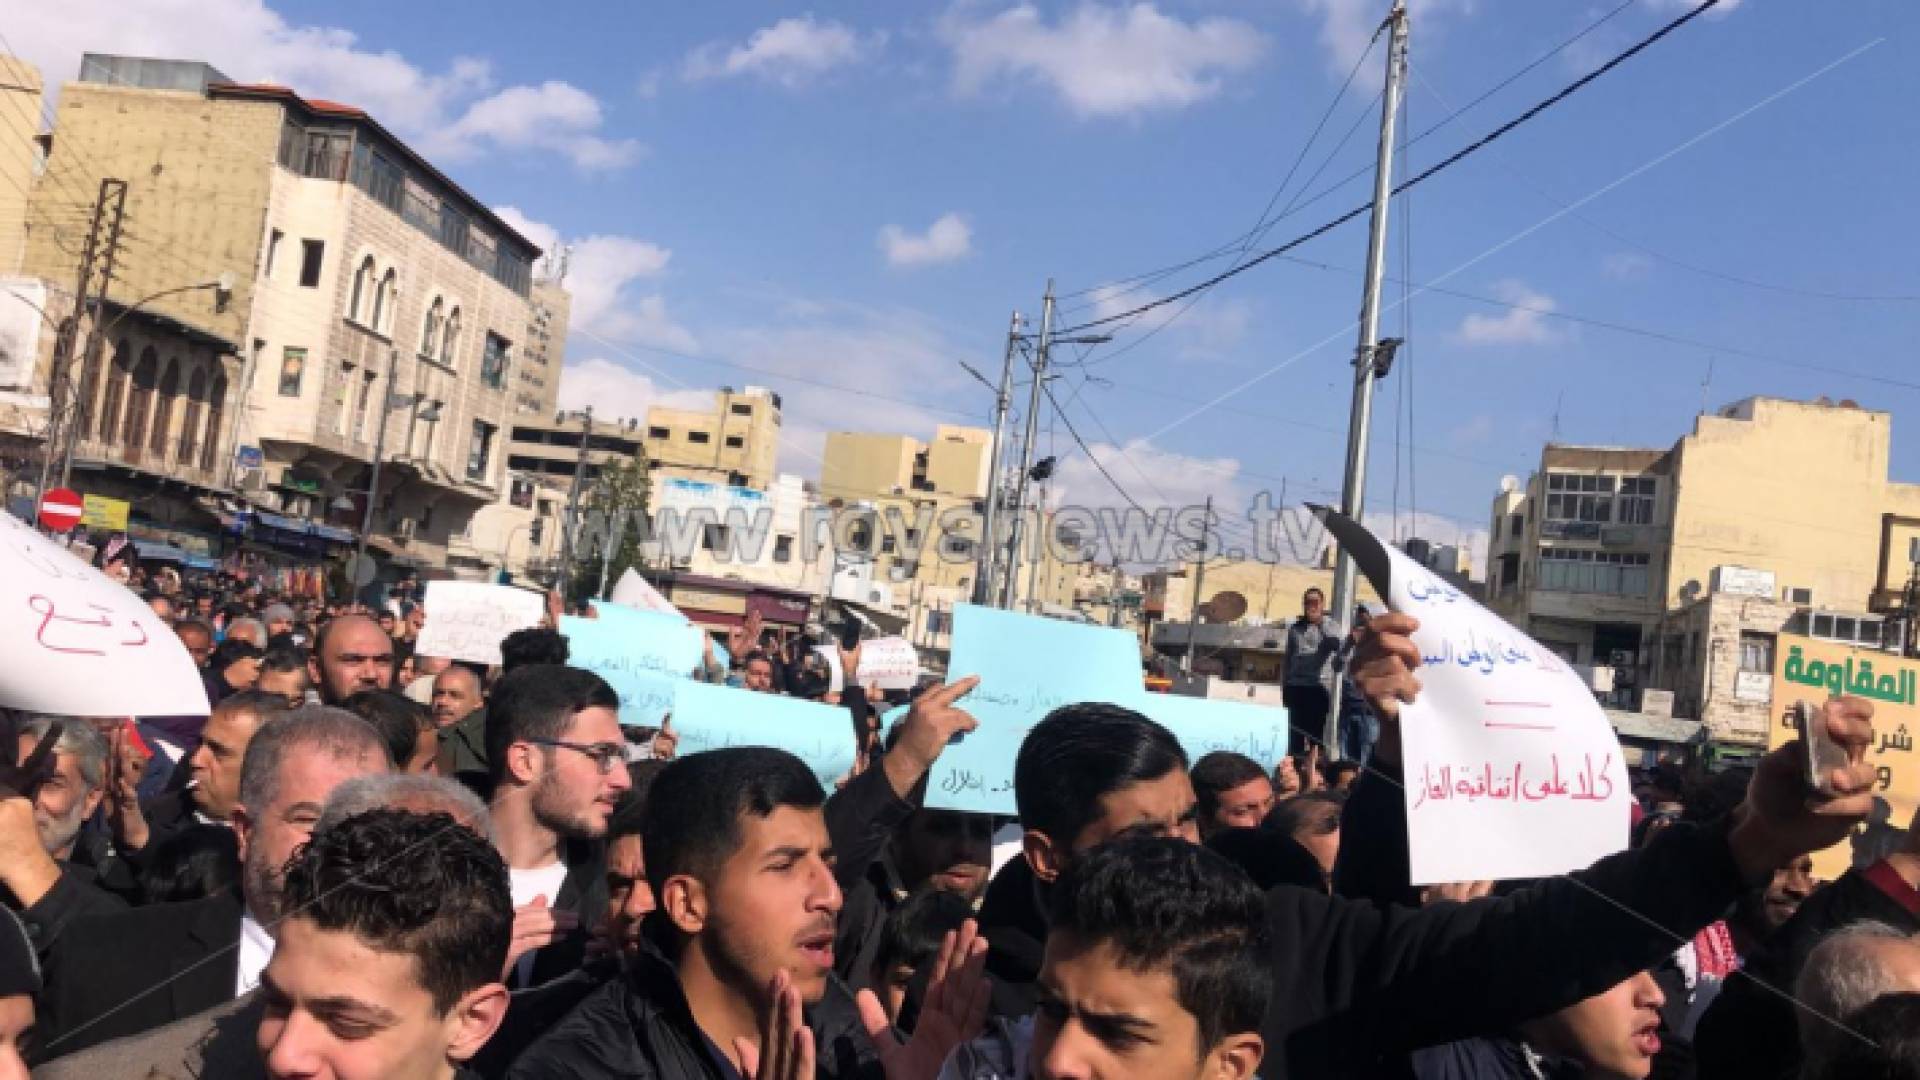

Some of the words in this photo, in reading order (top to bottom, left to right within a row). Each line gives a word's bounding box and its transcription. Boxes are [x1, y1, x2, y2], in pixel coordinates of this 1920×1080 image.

[1784, 645, 1916, 705] المقاومة
[1522, 752, 1569, 801] على
[1571, 752, 1613, 800] كلا
